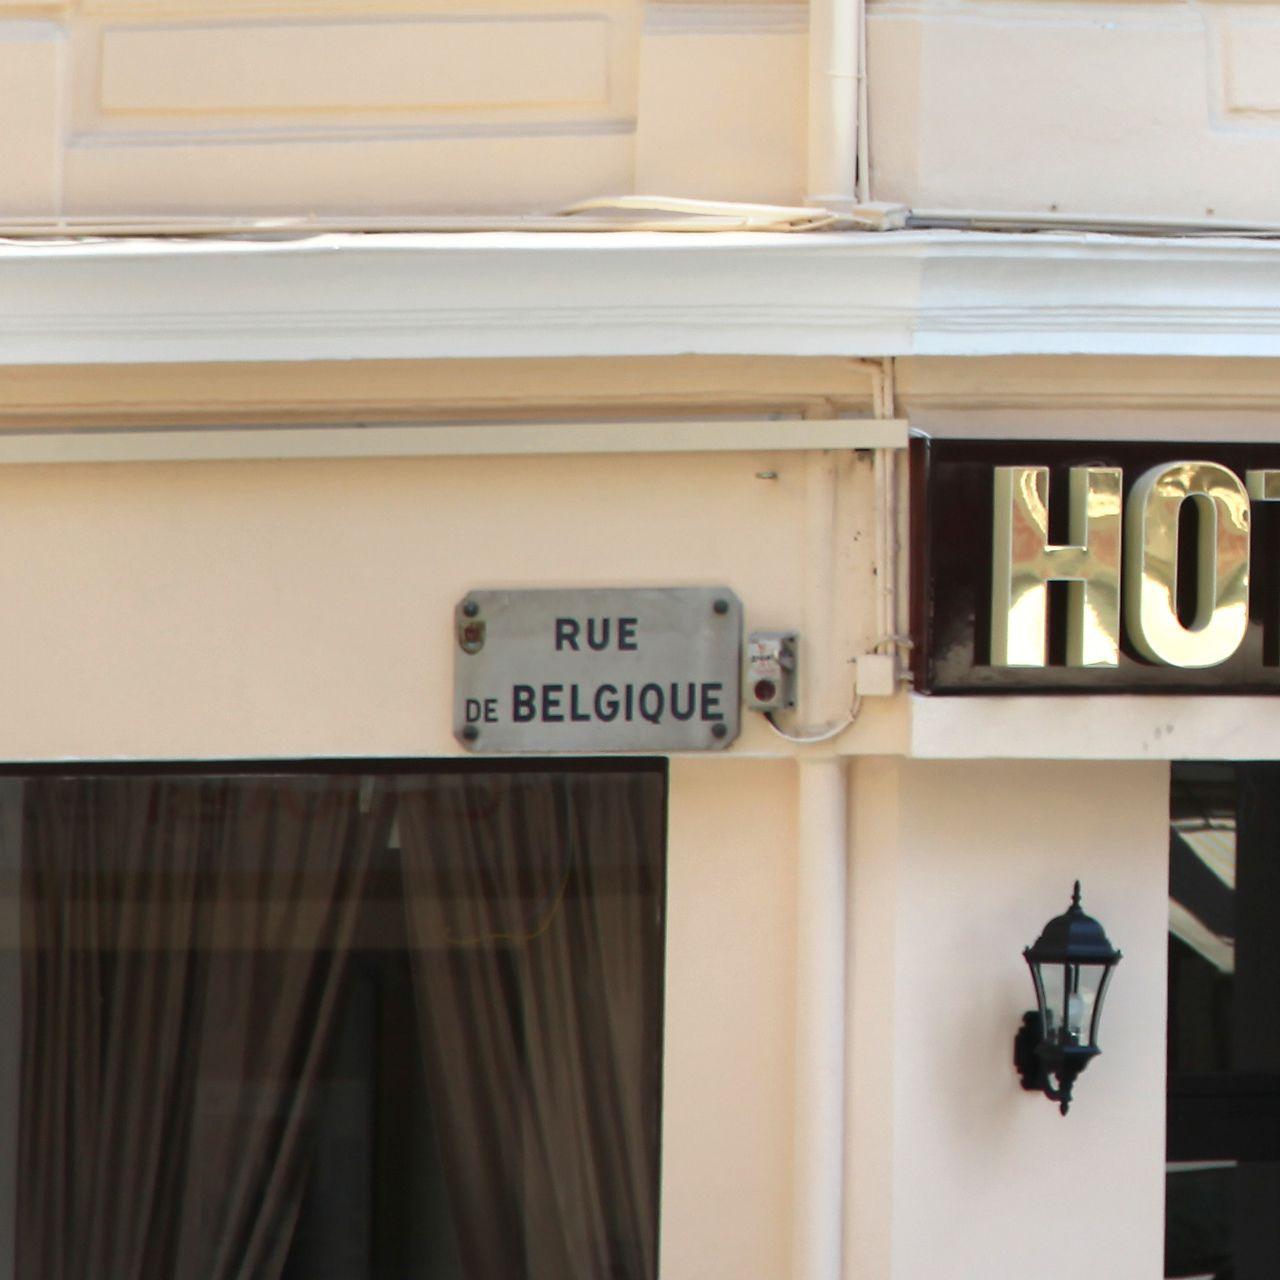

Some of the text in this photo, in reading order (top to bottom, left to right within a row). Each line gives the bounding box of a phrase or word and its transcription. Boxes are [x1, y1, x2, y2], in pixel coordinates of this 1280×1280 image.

[555, 618, 639, 651] RUE
[466, 683, 724, 724] DE BELGIQUE
